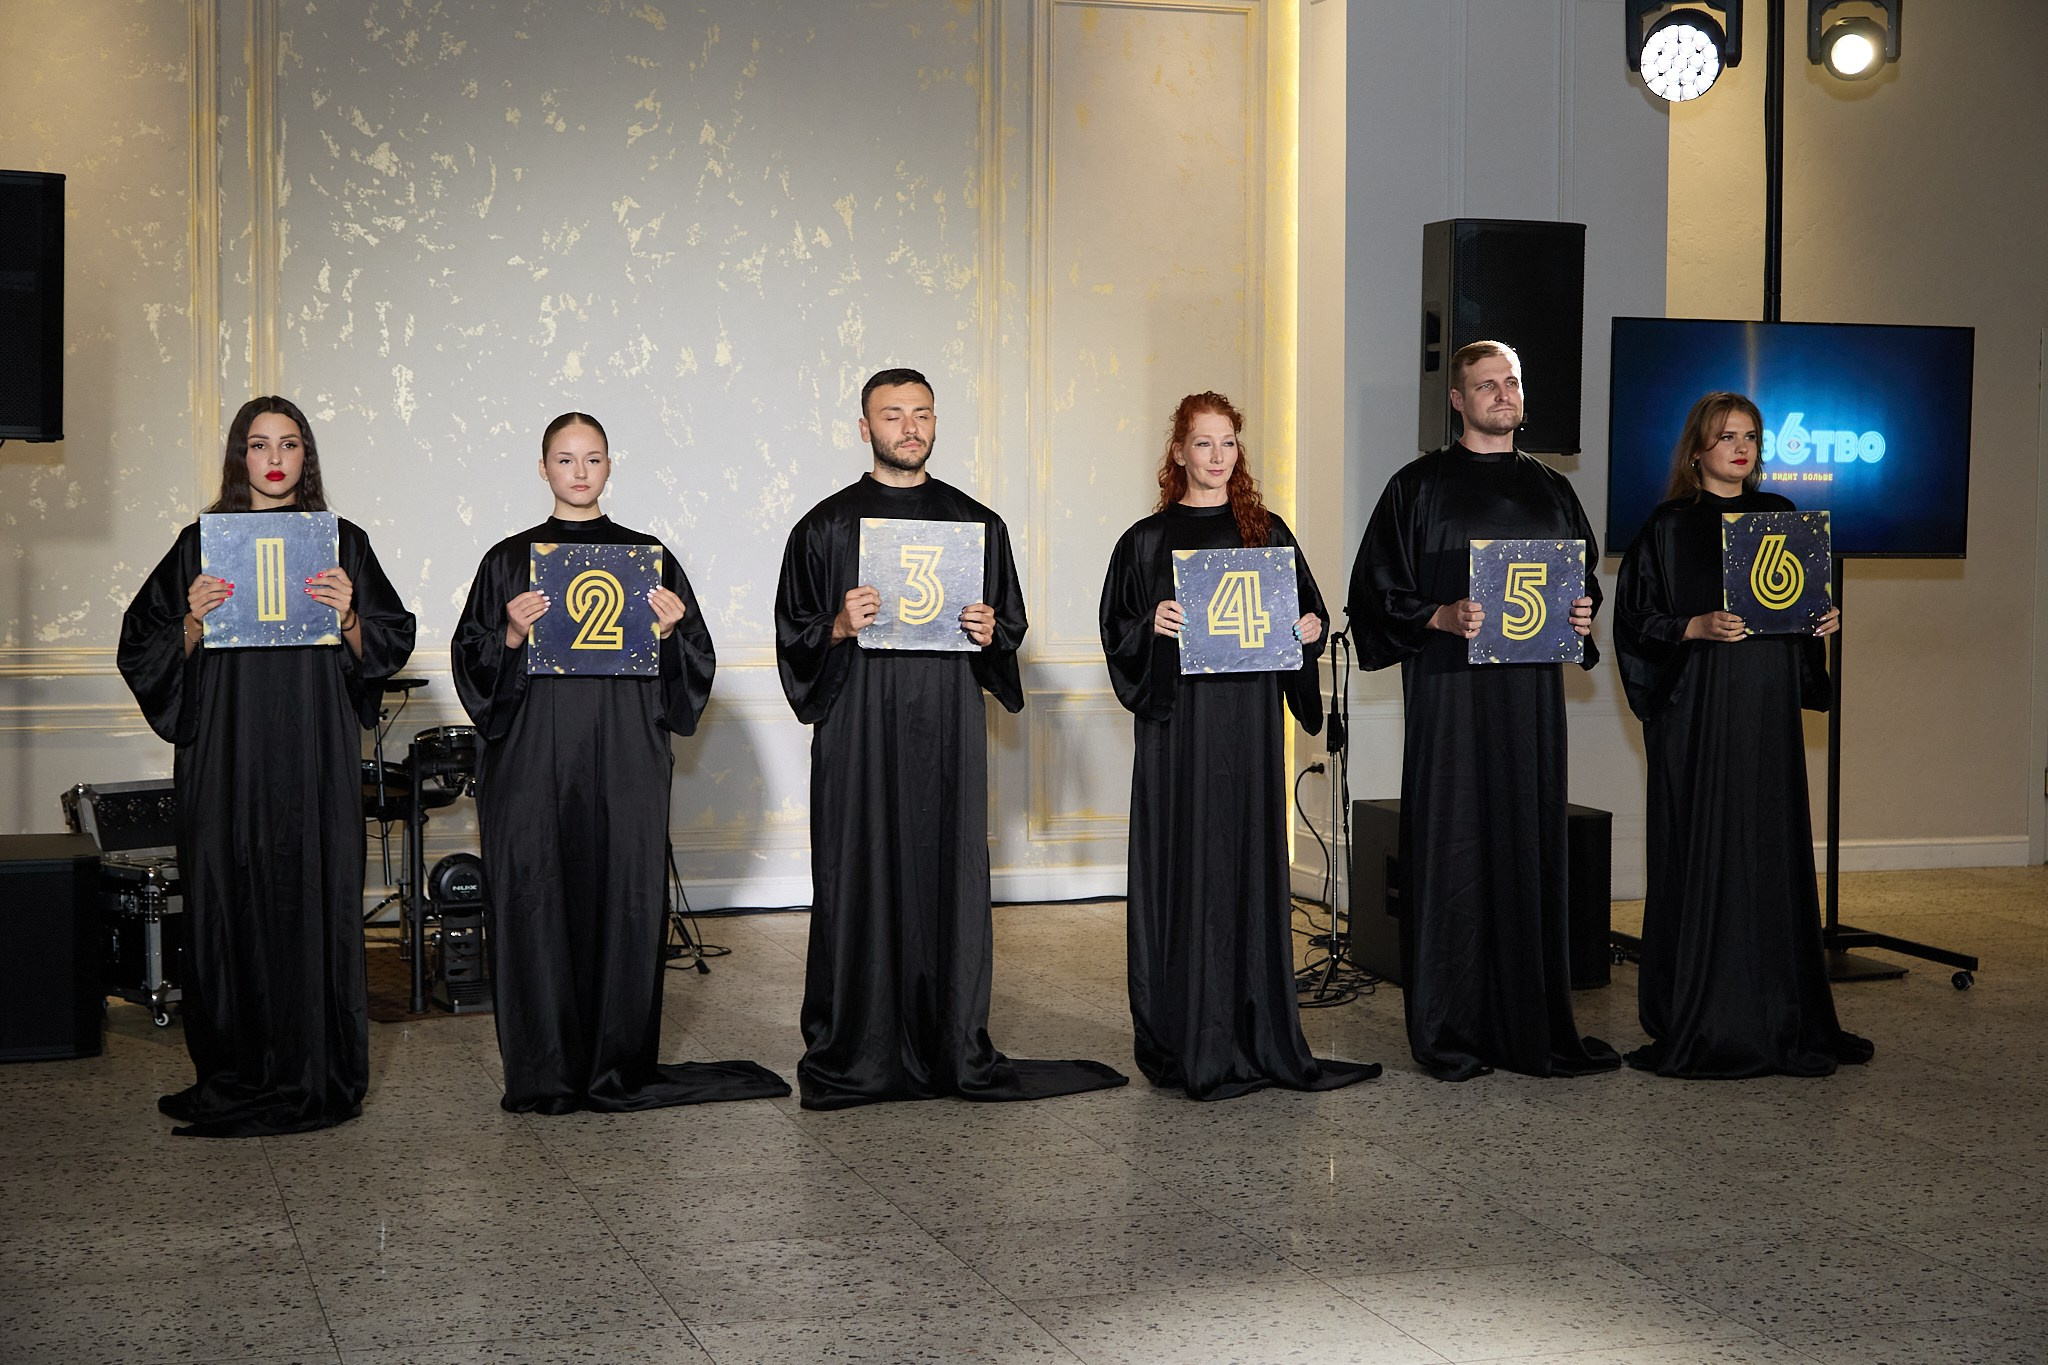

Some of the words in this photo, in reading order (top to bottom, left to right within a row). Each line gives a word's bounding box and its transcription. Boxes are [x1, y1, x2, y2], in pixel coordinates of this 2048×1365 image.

[1772, 472, 1798, 482] ВИДИТ
[1802, 472, 1834, 482] БОЛЬШЕ
[566, 569, 625, 651] 2
[899, 545, 944, 625] 3
[1207, 570, 1271, 649] 4
[1502, 562, 1547, 641] 5
[1750, 534, 1805, 611] 6
